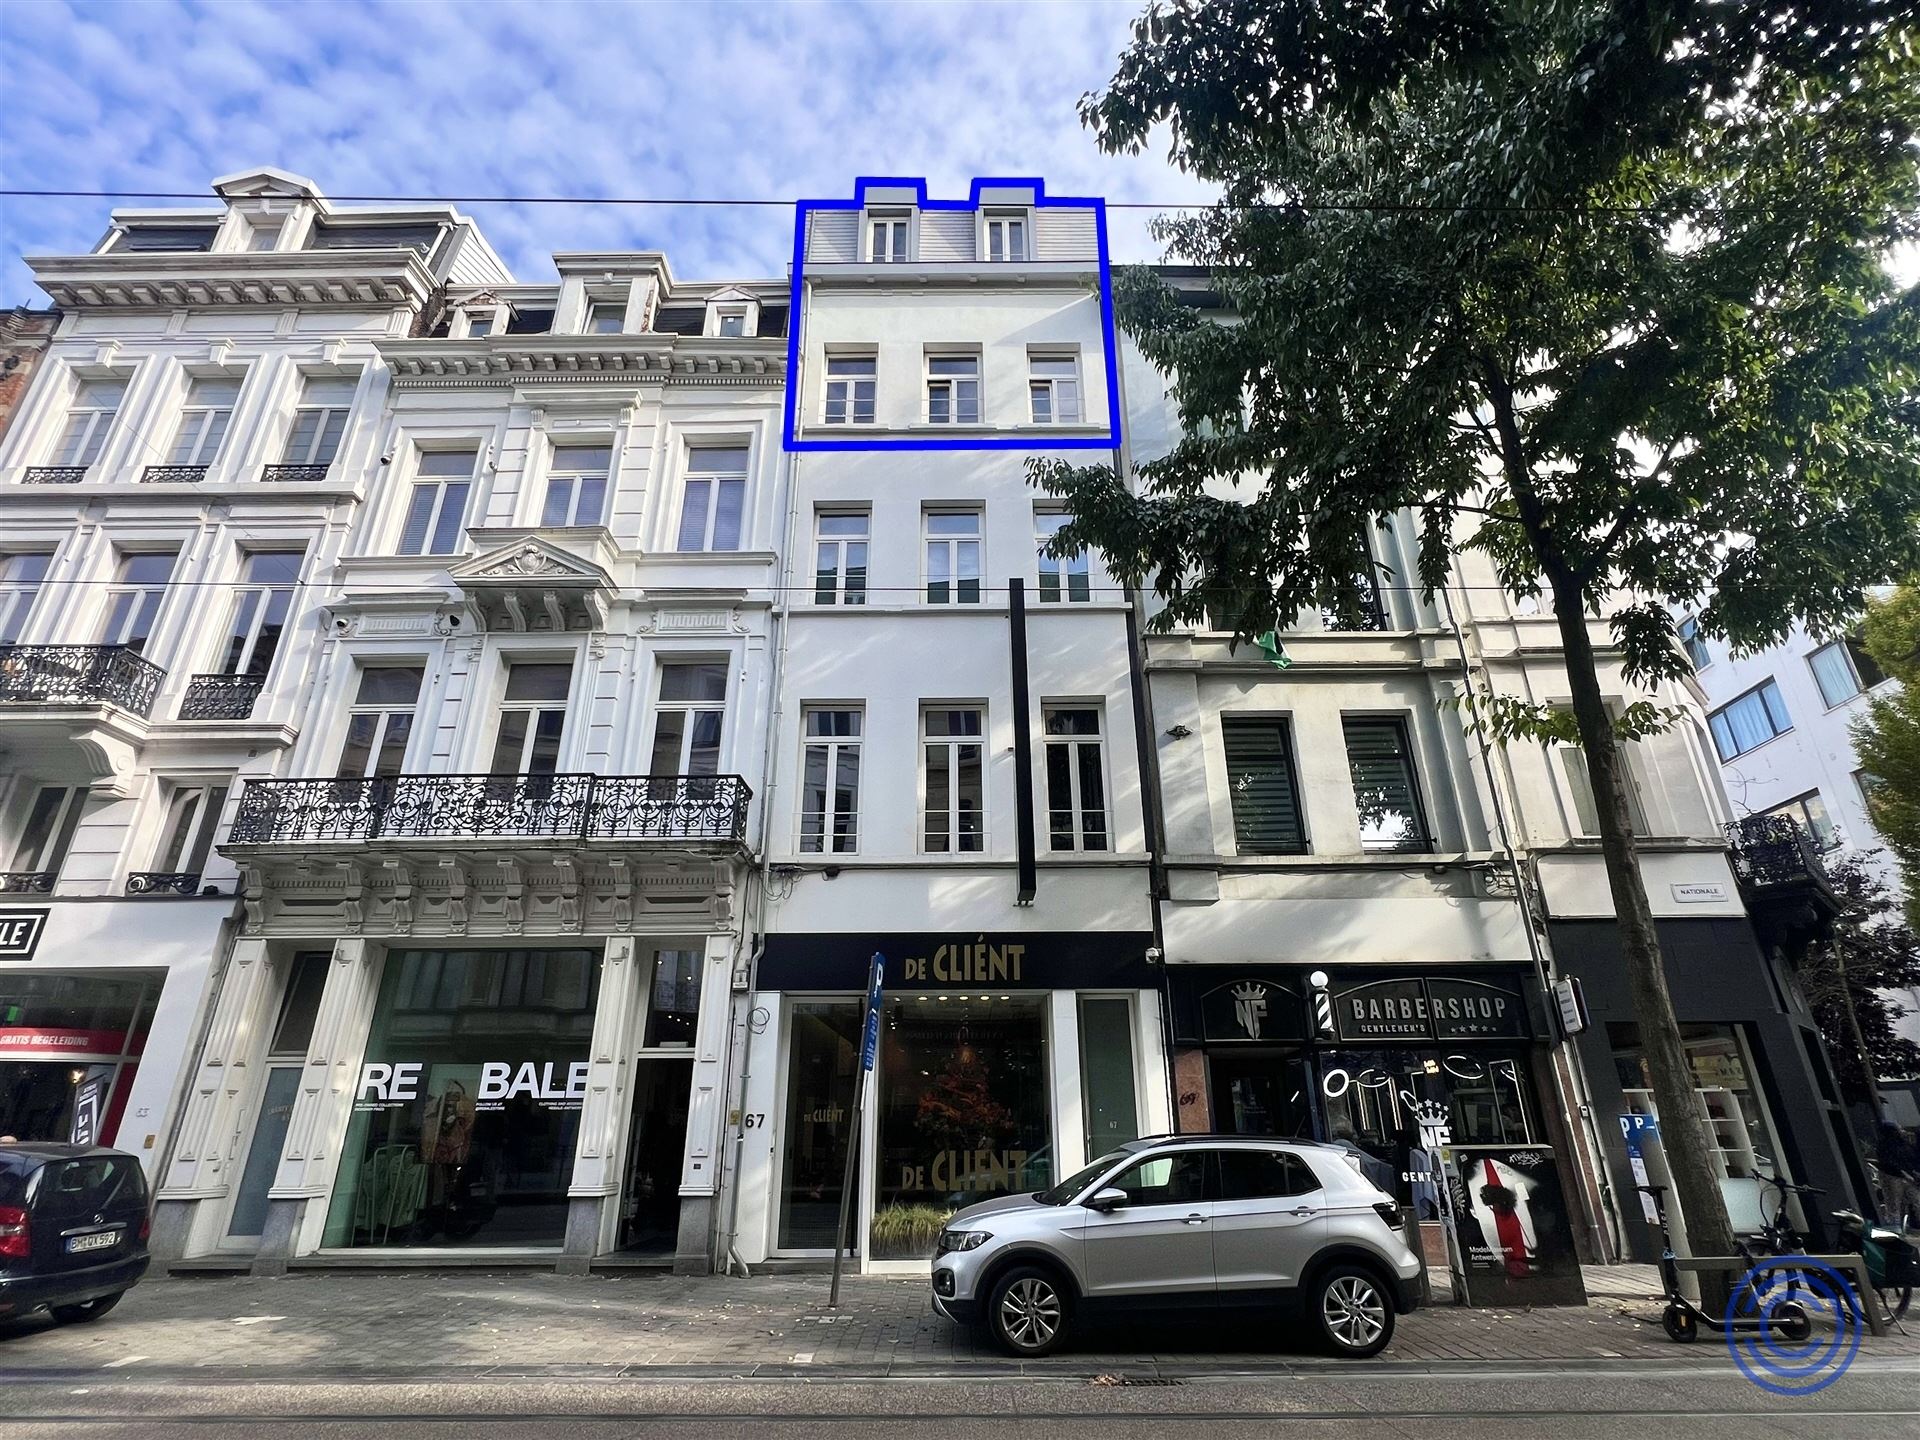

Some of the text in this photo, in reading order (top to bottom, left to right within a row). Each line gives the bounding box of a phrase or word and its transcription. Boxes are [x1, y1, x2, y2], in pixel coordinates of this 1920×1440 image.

[905, 935, 1025, 982] DE CLIÉNT
[1235, 999, 1268, 1040] NF
[1352, 997, 1506, 1020] BARBERSHOP
[1361, 1023, 1426, 1033] GENTLEMEN'S
[0, 1035, 89, 1046] GRATIS BEGELEIDING
[356, 1061, 590, 1100] RE BALE
[745, 1113, 765, 1128] 67
[1619, 1117, 1631, 1139] P
[1634, 1117, 1644, 1129] P
[902, 1165, 924, 1191] DE
